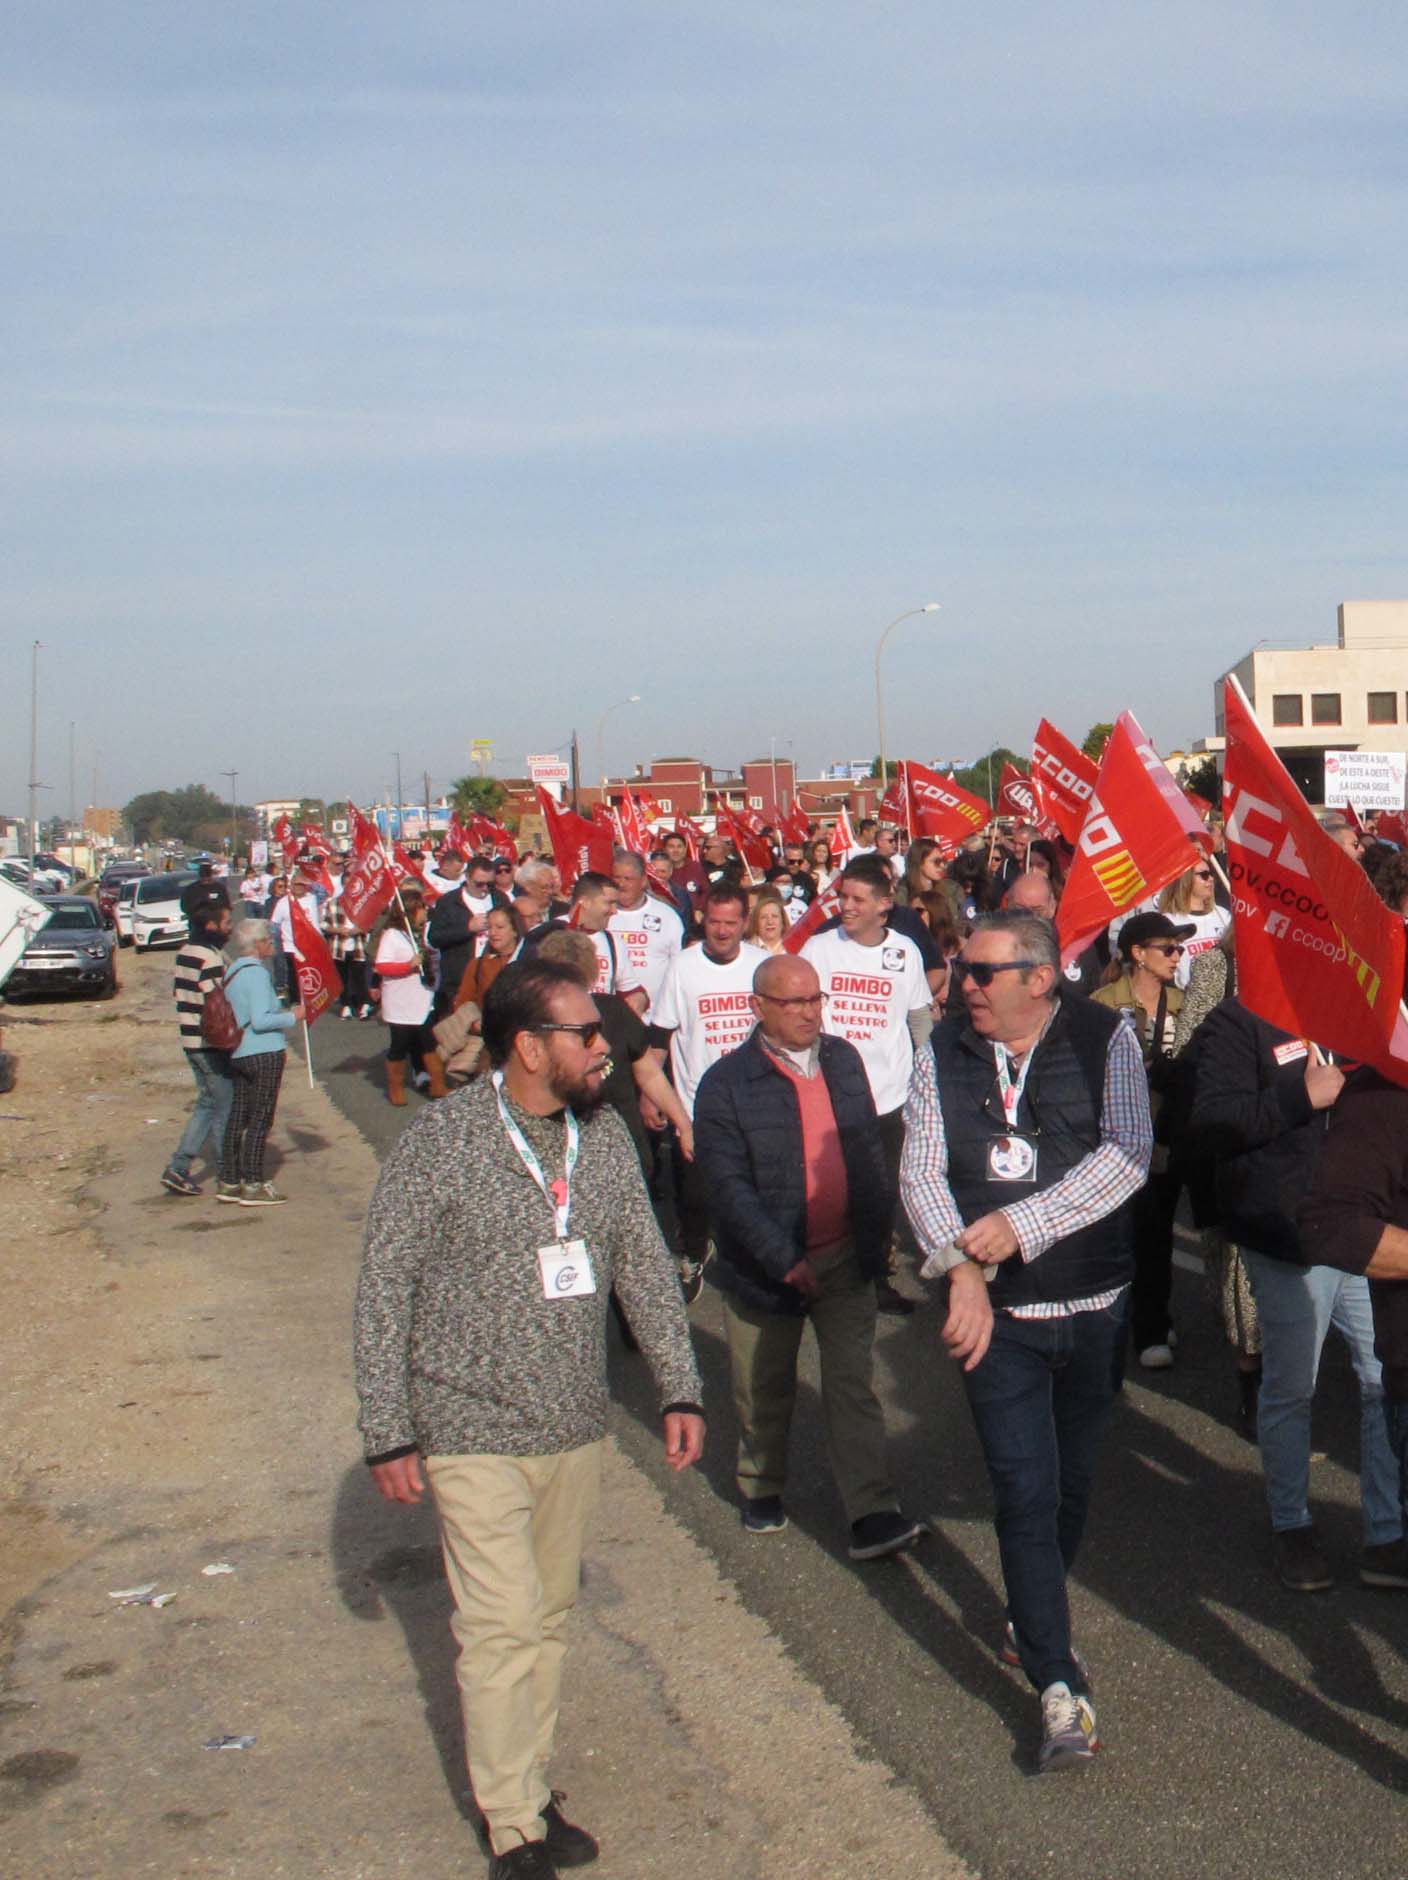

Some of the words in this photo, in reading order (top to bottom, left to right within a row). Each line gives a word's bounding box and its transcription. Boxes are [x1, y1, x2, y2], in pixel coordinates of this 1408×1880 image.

[1349, 755, 1369, 763] NORTE
[1349, 768, 1364, 776] ESTE
[1371, 768, 1389, 777] OESTE
[1350, 782, 1371, 791] LUCHA
[1372, 782, 1390, 791] SIGUE
[1361, 795, 1376, 805] QUE
[831, 975, 893, 997] BIMBO
[833, 1000, 849, 1011] SE
[851, 1001, 888, 1014] LLEVA
[704, 1021, 721, 1032] SE
[723, 1017, 756, 1030] LLEV
[831, 1014, 889, 1029] NUESTRO
[704, 1031, 749, 1046] NUEST
